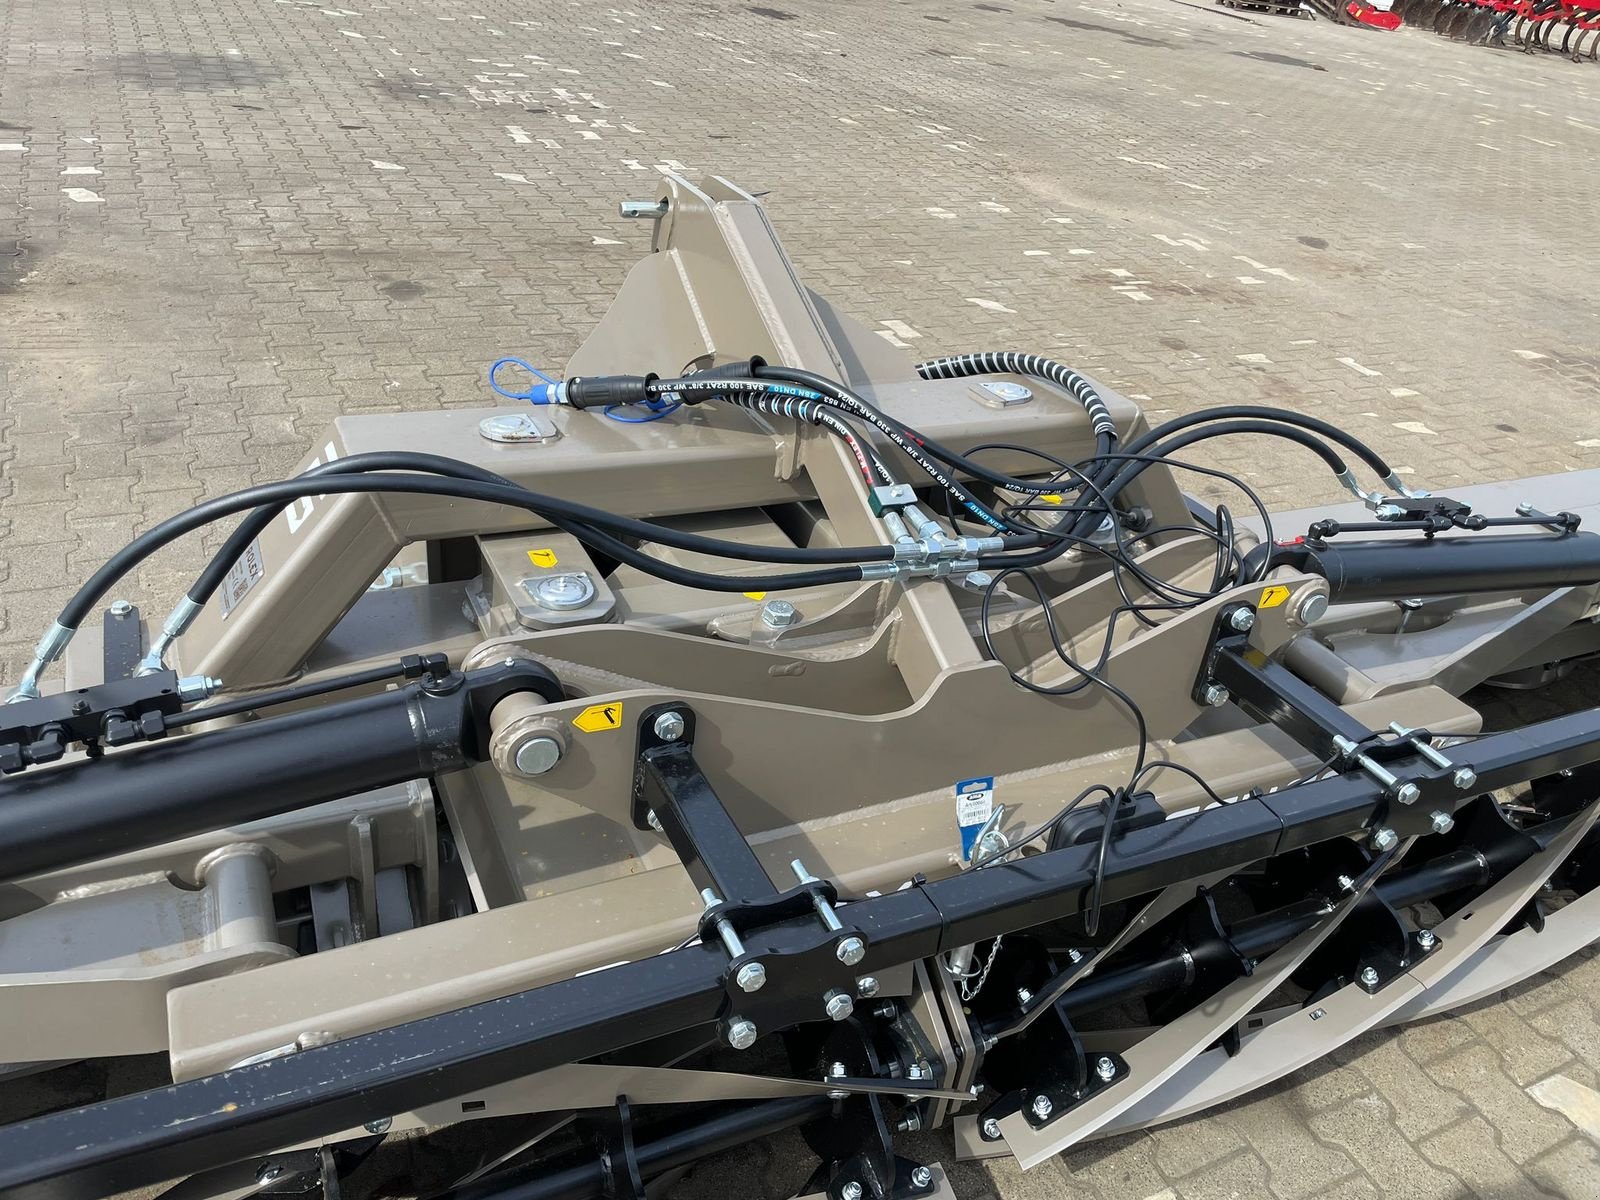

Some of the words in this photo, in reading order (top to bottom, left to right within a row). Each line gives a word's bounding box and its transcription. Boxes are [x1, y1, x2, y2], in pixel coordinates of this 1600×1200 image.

[706, 382, 728, 390] R2AT
[774, 386, 796, 394] DN10
[798, 389, 815, 399] 2SN
[860, 408, 876, 421] BAR
[877, 421, 891, 434] 330
[891, 433, 904, 445] WP
[917, 457, 937, 476] R2AT
[936, 475, 949, 488] 100
[949, 487, 965, 501] SAE
[970, 505, 988, 520] DN10
